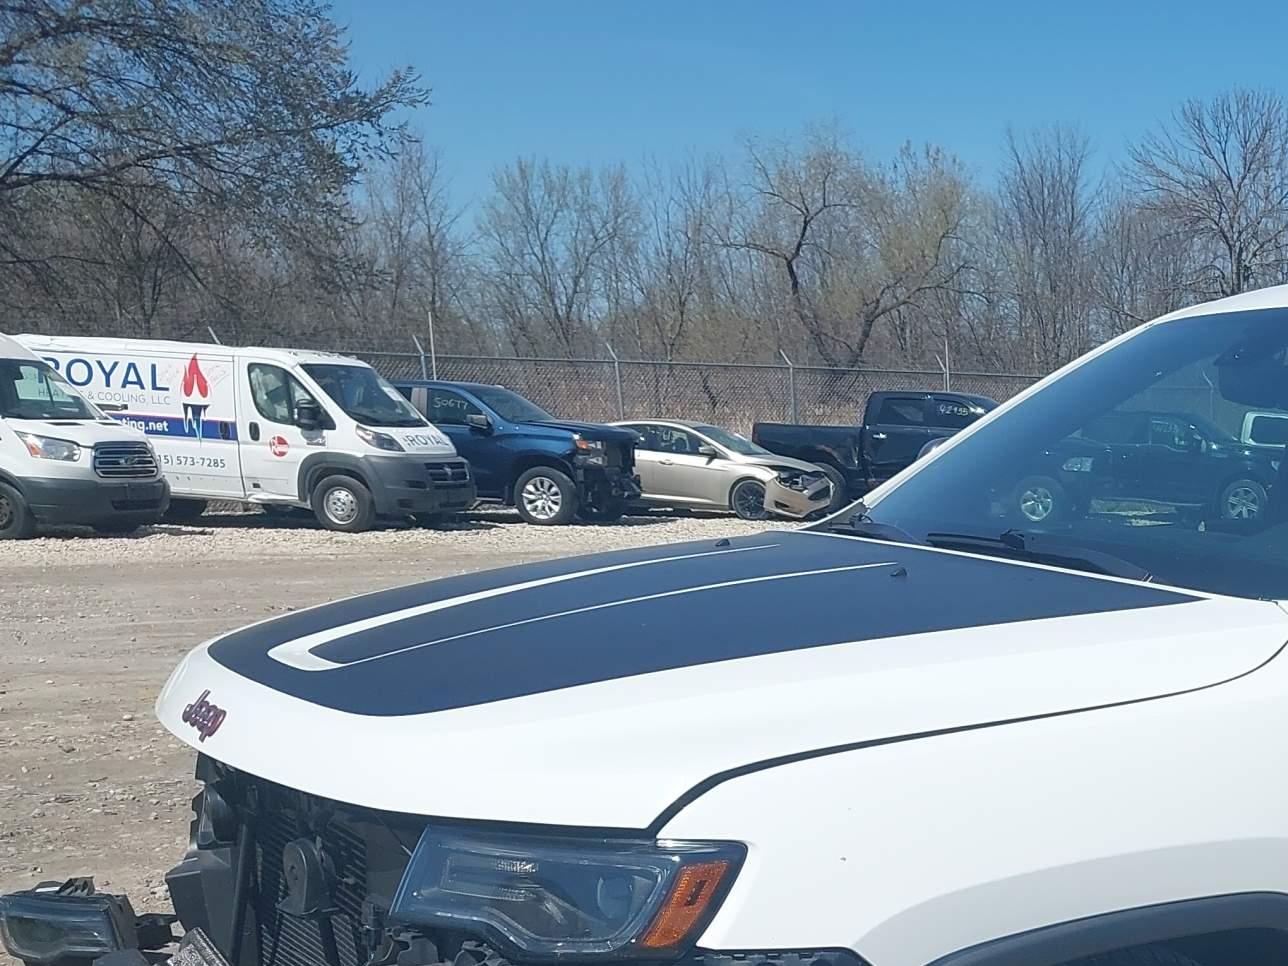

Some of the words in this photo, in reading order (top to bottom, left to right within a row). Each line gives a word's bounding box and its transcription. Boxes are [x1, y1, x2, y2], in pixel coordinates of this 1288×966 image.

[88, 391, 95, 400] &
[152, 395, 170, 404] LLC
[405, 434, 449, 446] ROYAL
[176, 456, 226, 469] 573-7285
